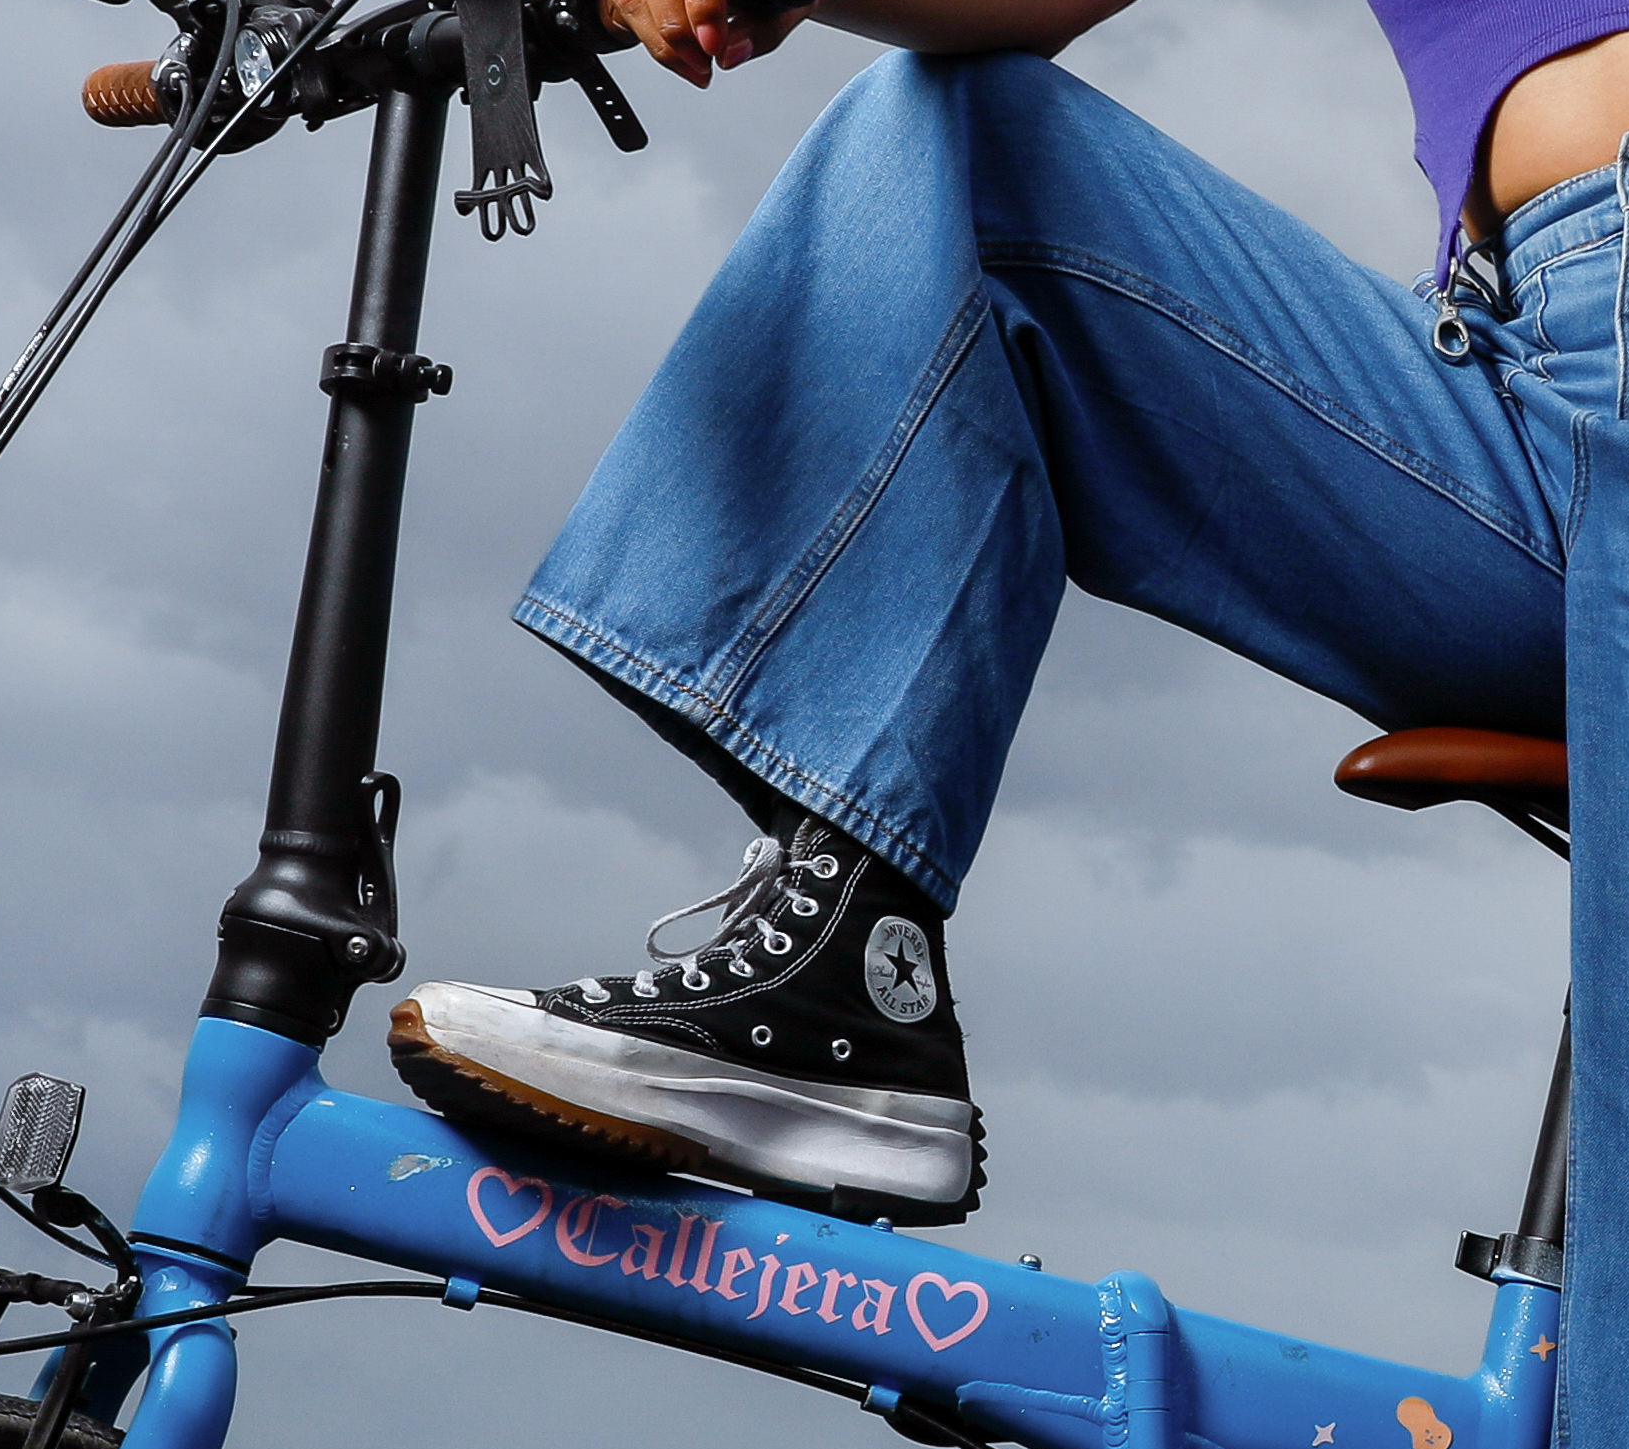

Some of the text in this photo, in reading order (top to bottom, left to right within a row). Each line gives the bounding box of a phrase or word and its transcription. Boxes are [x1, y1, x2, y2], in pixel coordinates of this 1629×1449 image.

[877, 985, 932, 1014] ALL STAR
[555, 1194, 898, 1336] Callejera
